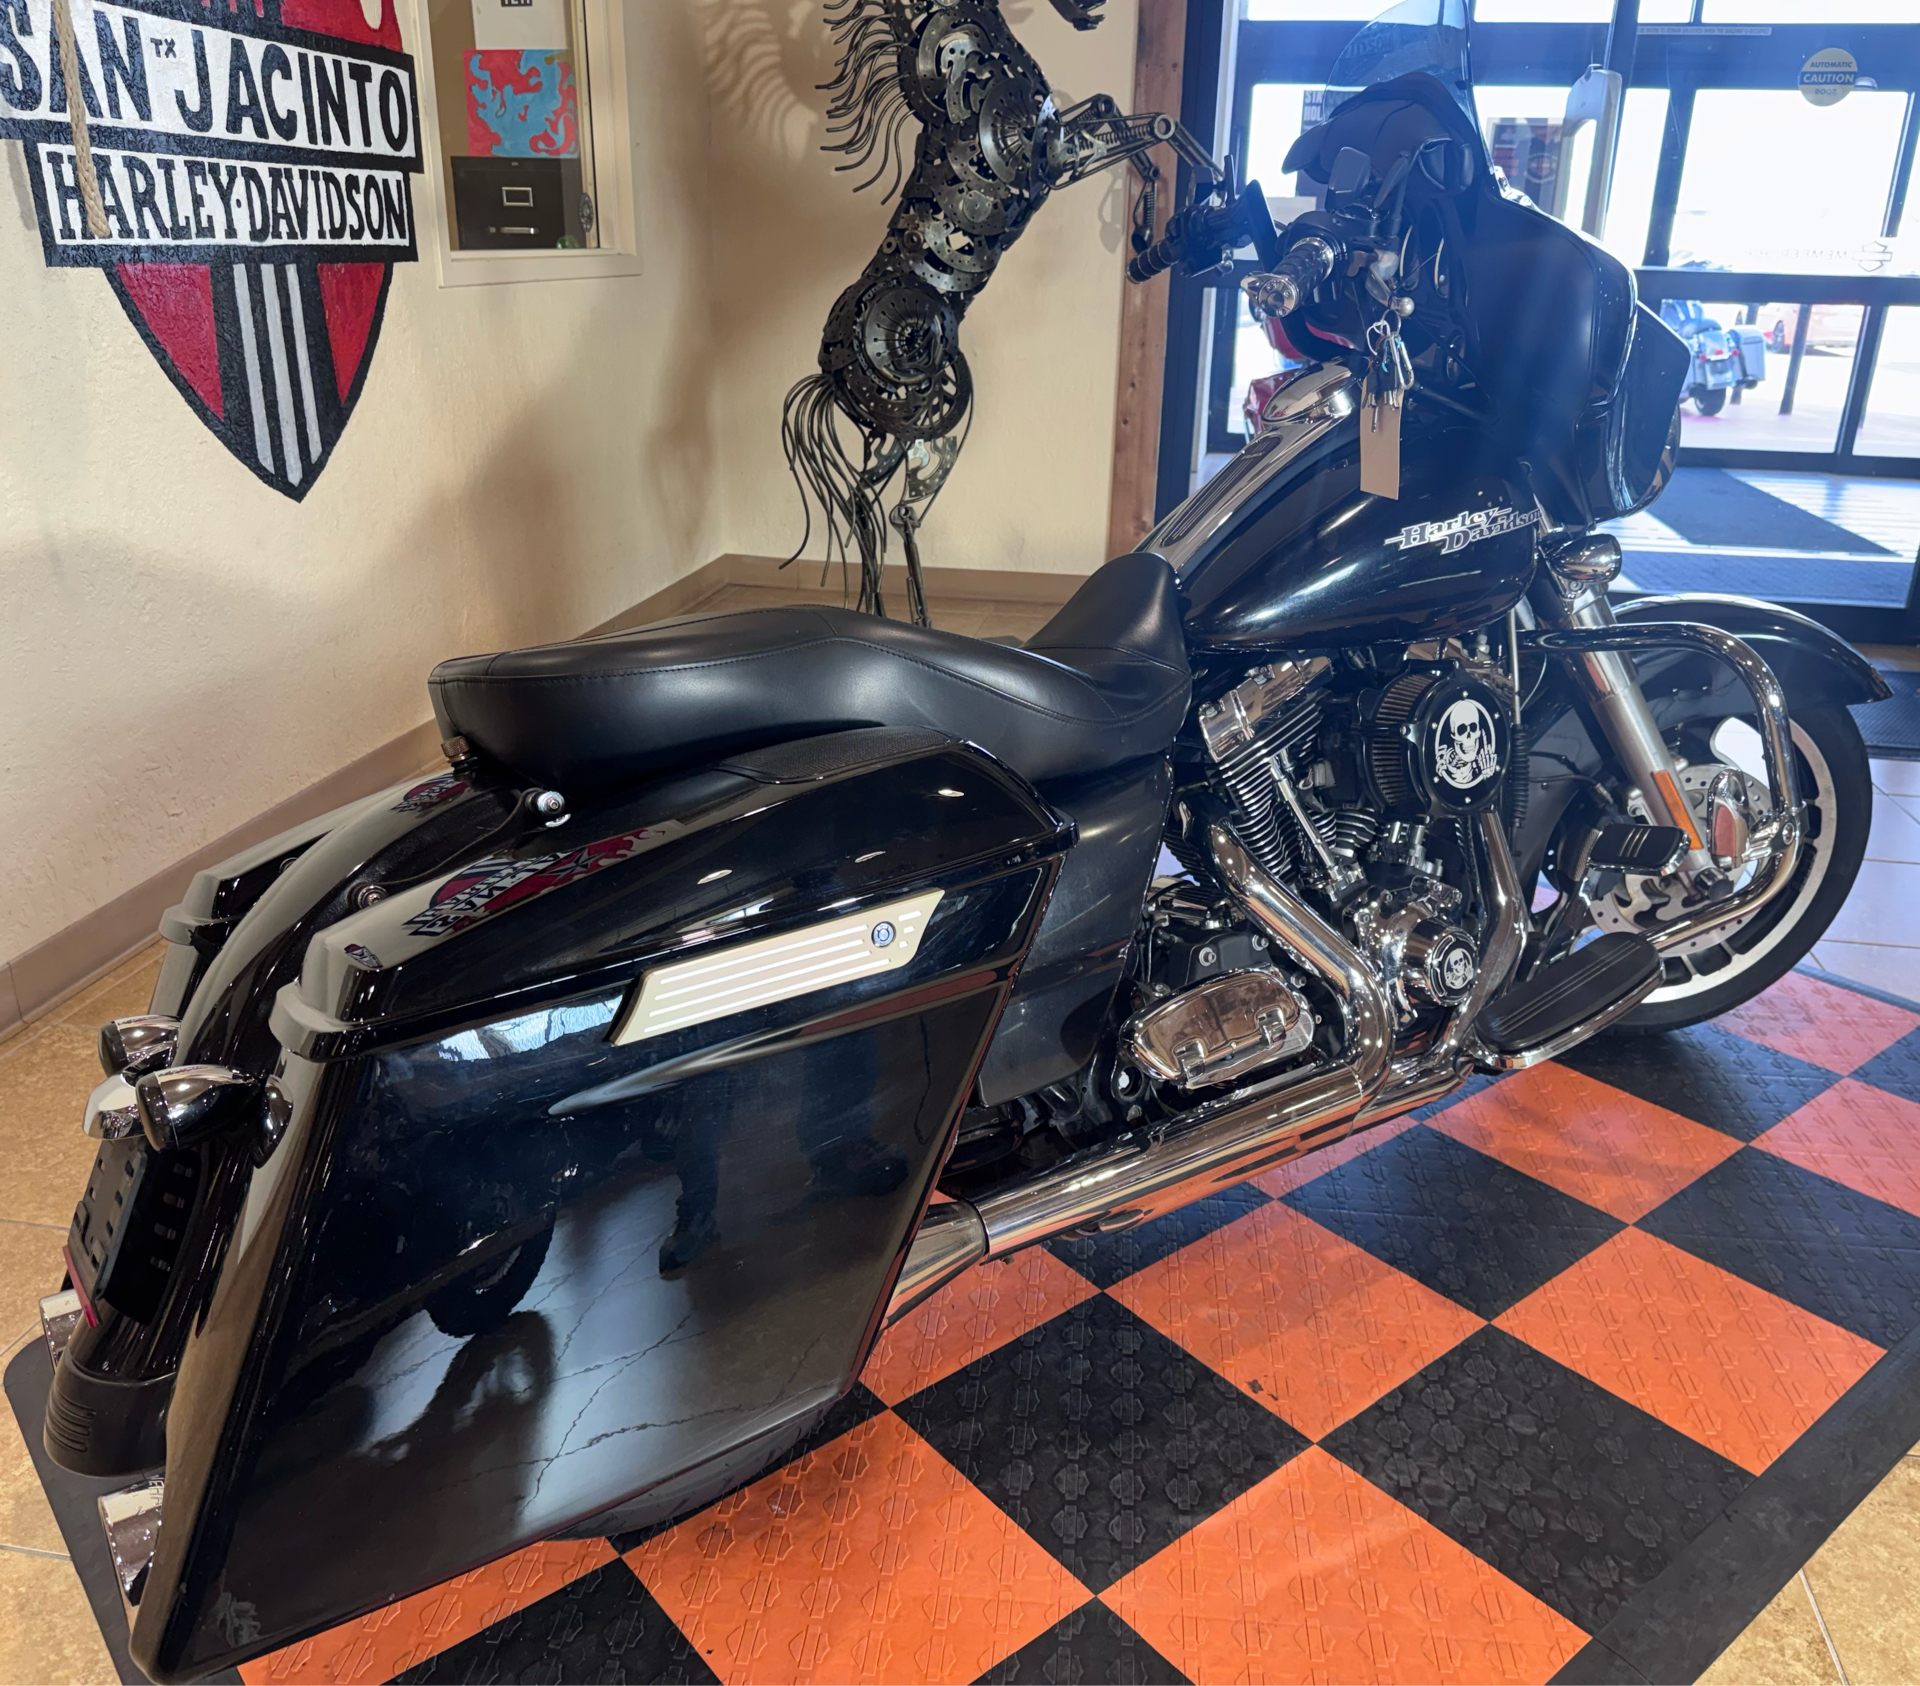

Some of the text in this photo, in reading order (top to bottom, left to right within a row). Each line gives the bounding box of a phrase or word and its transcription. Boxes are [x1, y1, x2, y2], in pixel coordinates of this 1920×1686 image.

[0, 0, 152, 121] SAN
[174, 29, 409, 151] JACINTO
[1803, 73, 1855, 83] CAUTION
[1396, 507, 1501, 551] Harley
